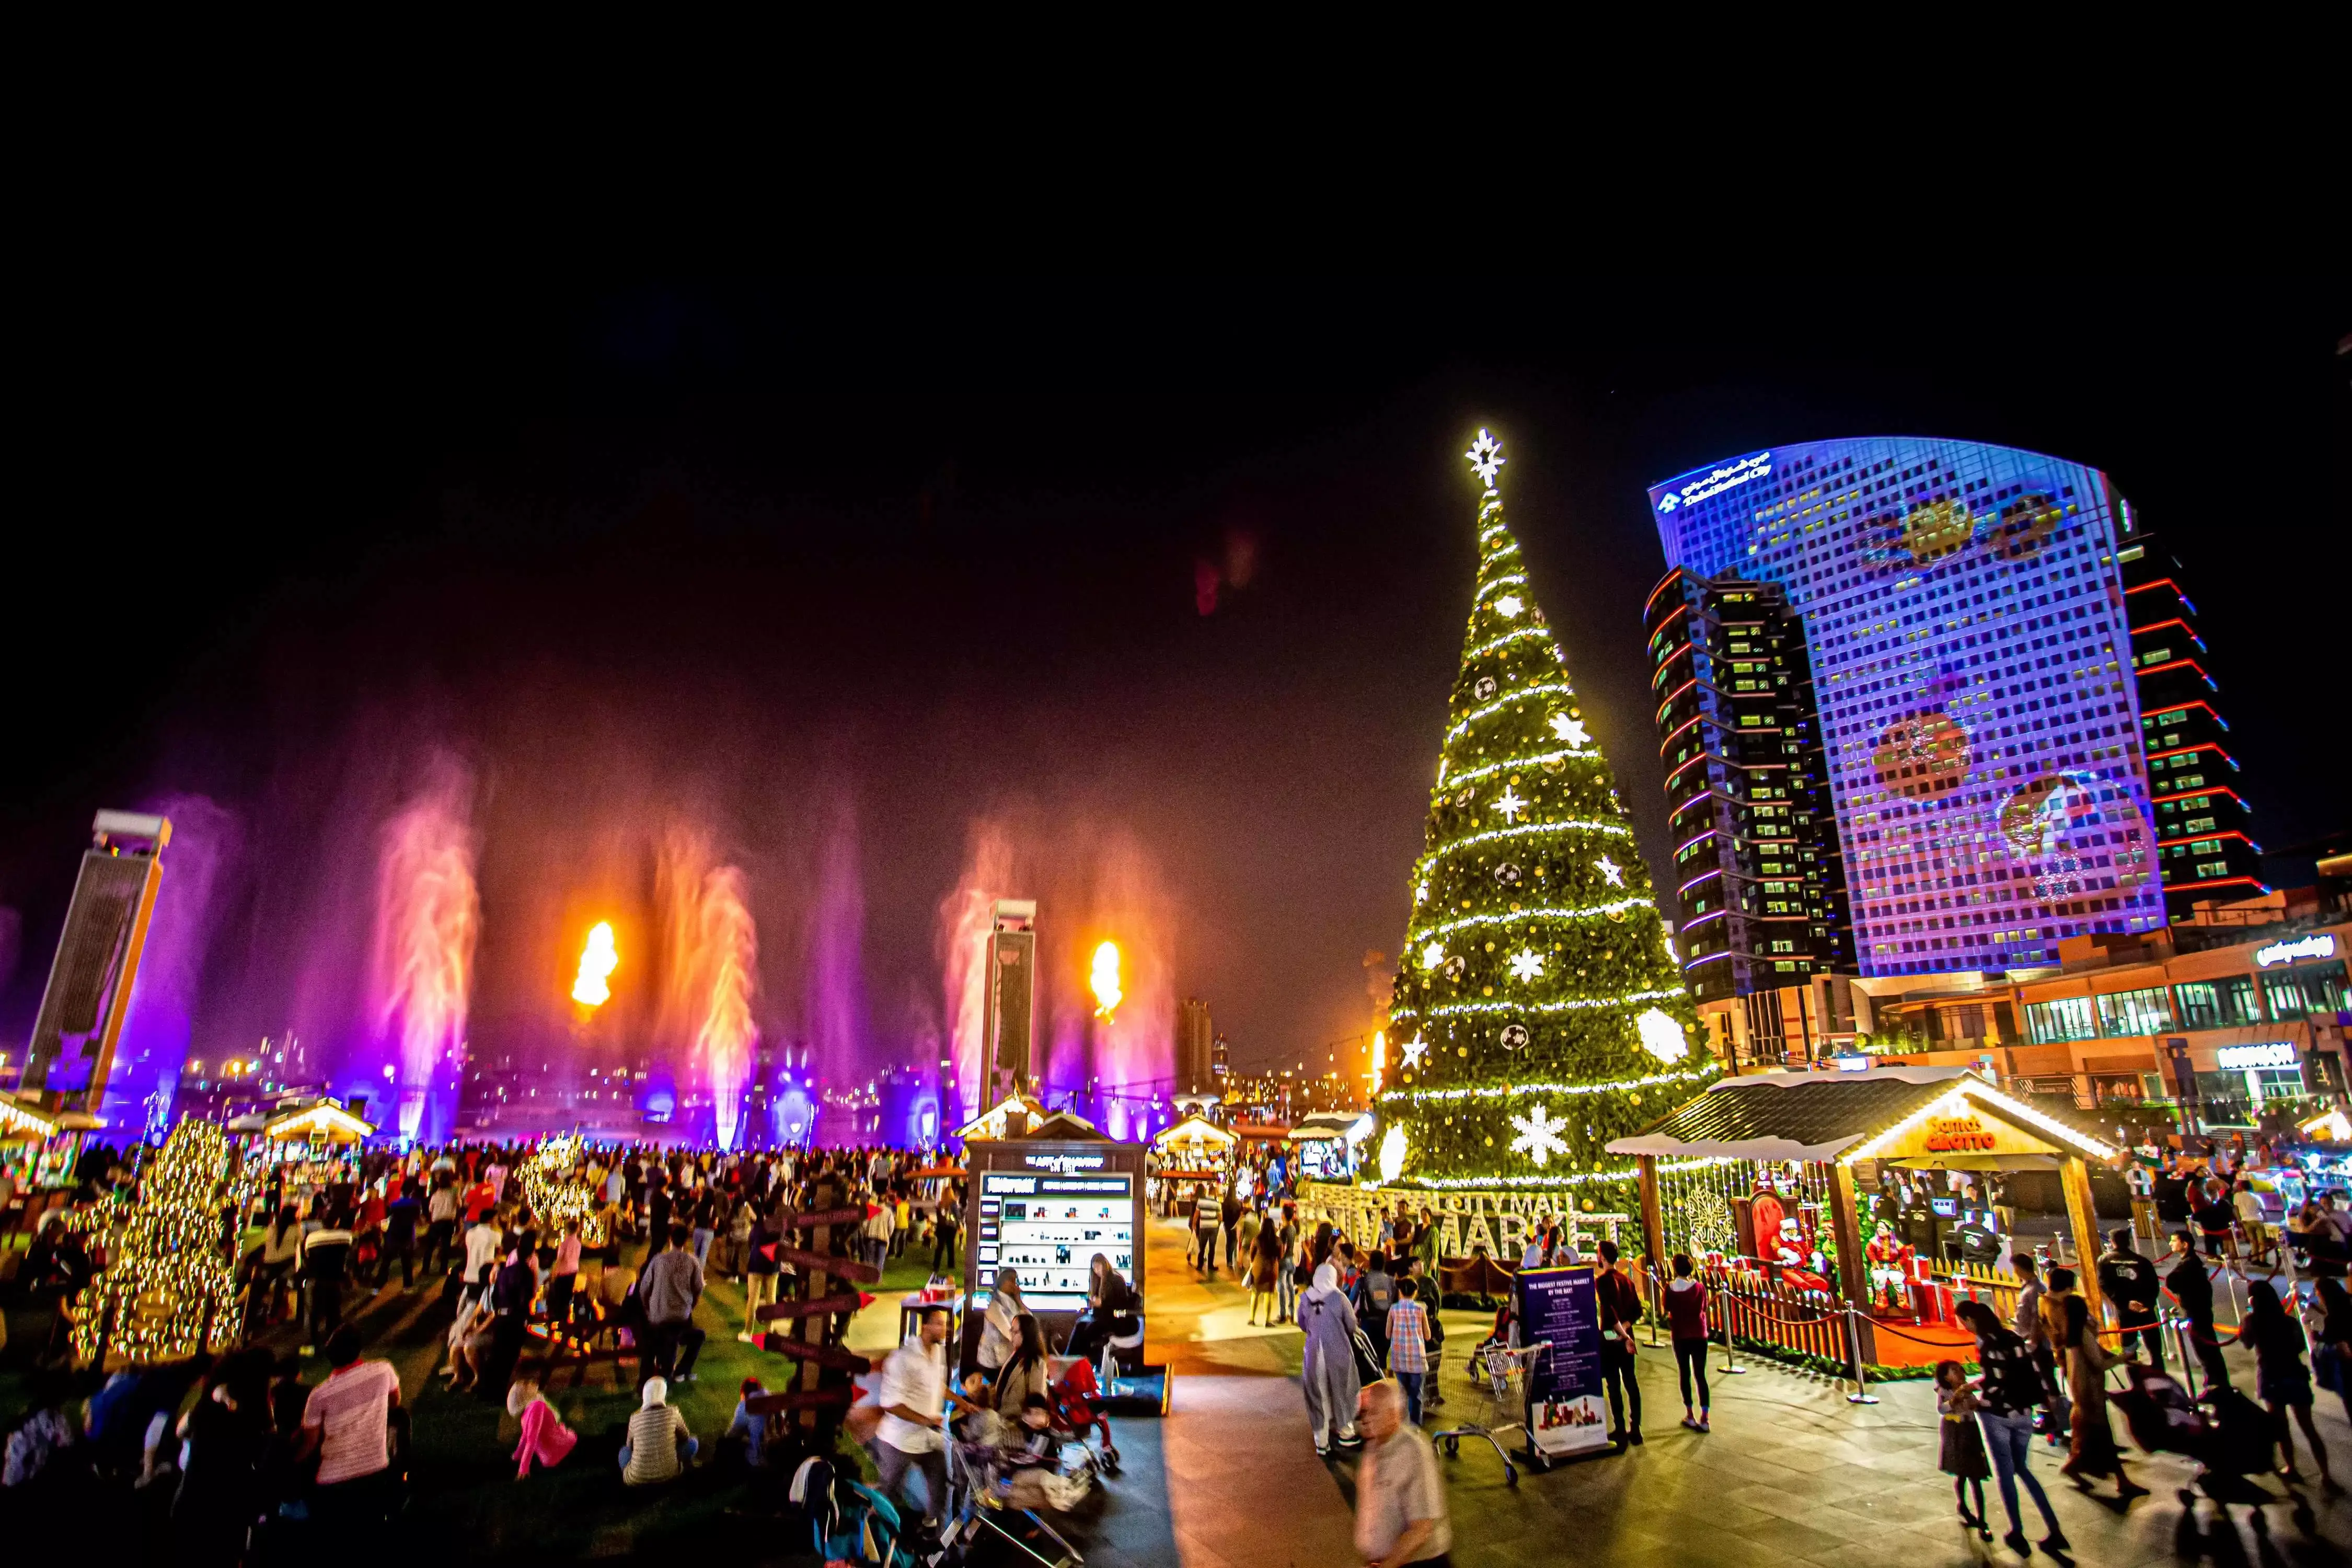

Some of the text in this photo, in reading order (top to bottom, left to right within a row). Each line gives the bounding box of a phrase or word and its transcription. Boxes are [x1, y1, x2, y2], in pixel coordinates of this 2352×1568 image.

[1927, 1132, 1996, 1150] GROTTO
[1445, 1191, 1506, 1216] CITY
[1509, 1192, 1581, 1216] MALL
[1556, 1279, 1573, 1287] FESTIVE
[1573, 1277, 1590, 1286] MARKET
